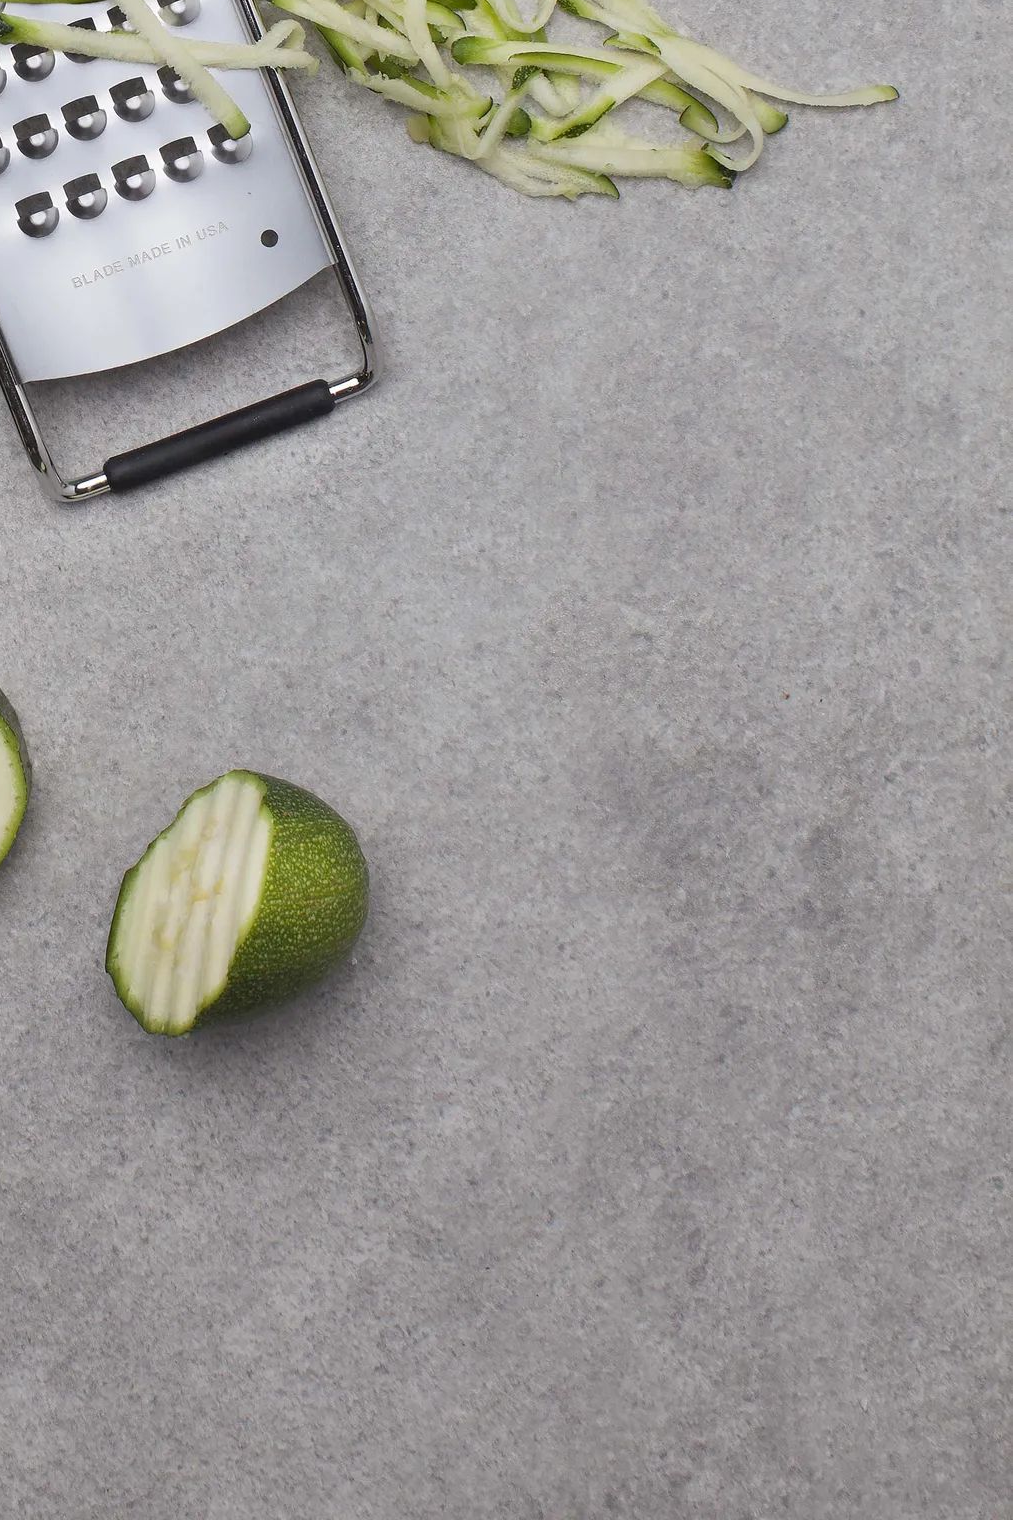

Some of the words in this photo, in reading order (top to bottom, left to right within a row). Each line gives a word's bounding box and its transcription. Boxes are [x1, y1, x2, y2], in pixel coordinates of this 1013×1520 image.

[71, 259, 124, 289] BLADE
[127, 242, 172, 268] MADE
[175, 233, 192, 250] IN
[195, 220, 229, 241] USA
